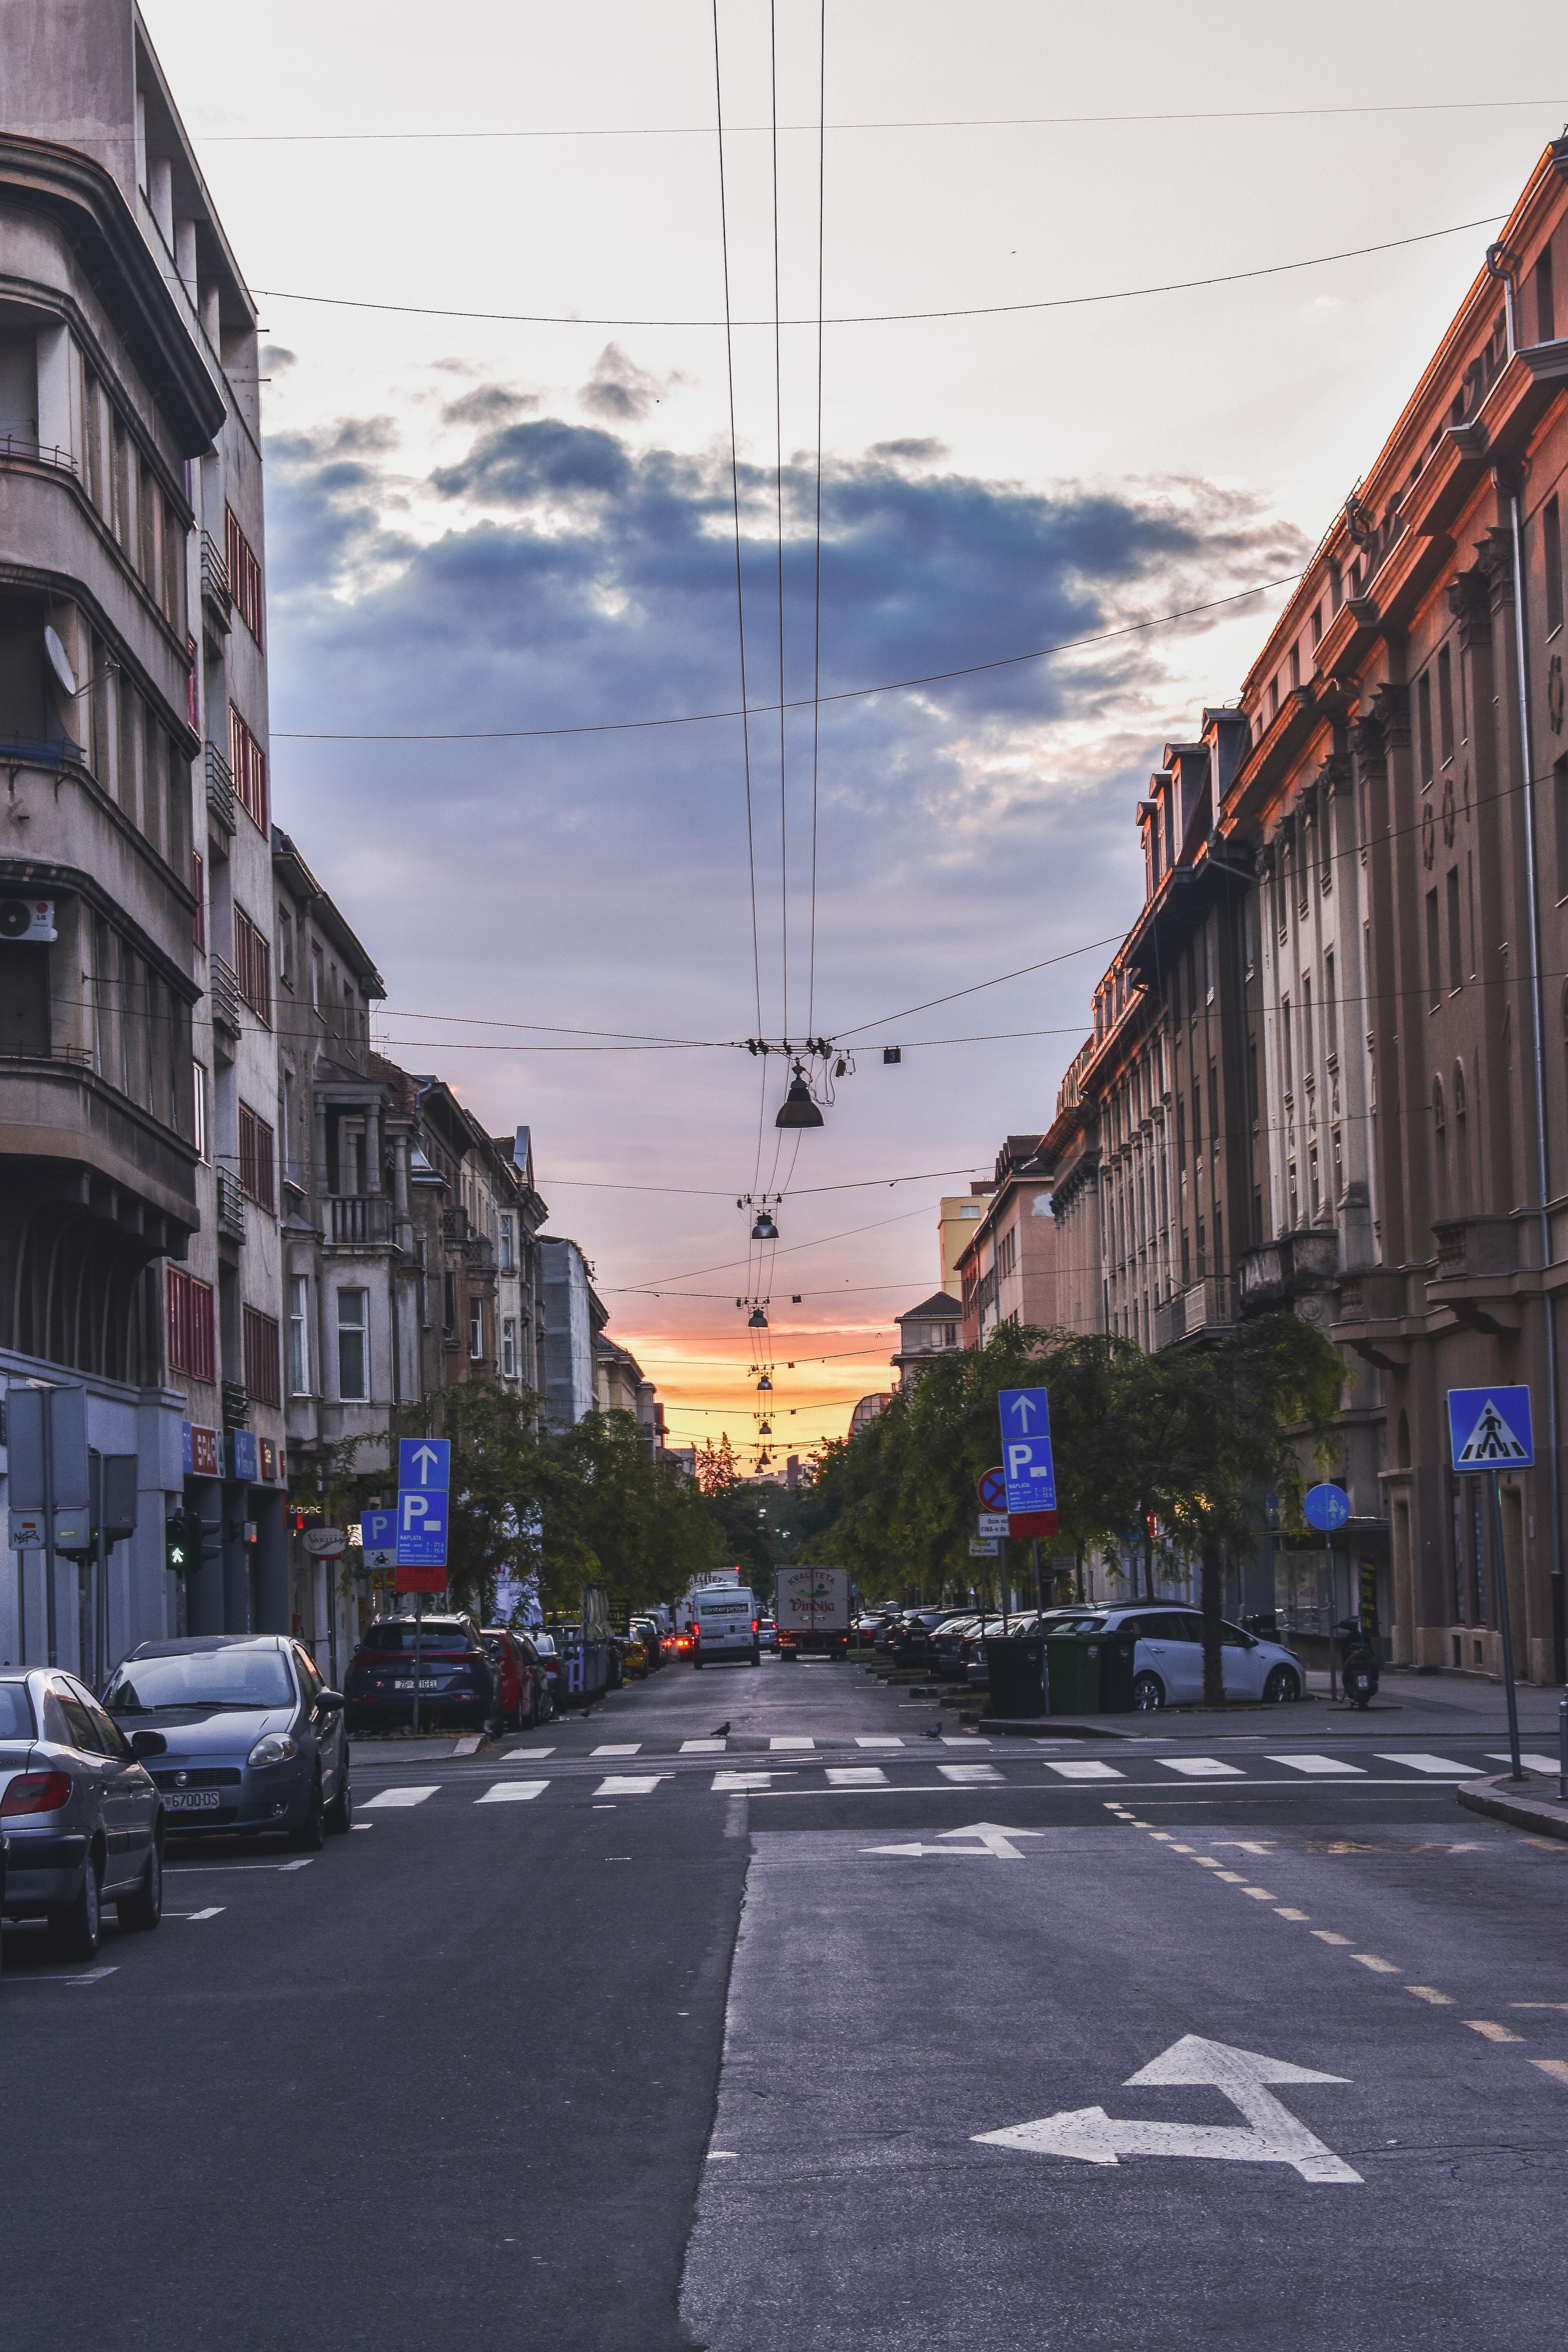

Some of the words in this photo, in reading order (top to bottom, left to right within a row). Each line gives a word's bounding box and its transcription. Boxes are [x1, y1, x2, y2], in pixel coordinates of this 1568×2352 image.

[198, 1435, 215, 1466] SPAR
[1009, 1445, 1033, 1479] P
[290, 1505, 322, 1514] 5asec
[404, 1495, 428, 1530] P
[372, 1516, 388, 1540] P
[172, 1793, 218, 1807] 6700-DS
